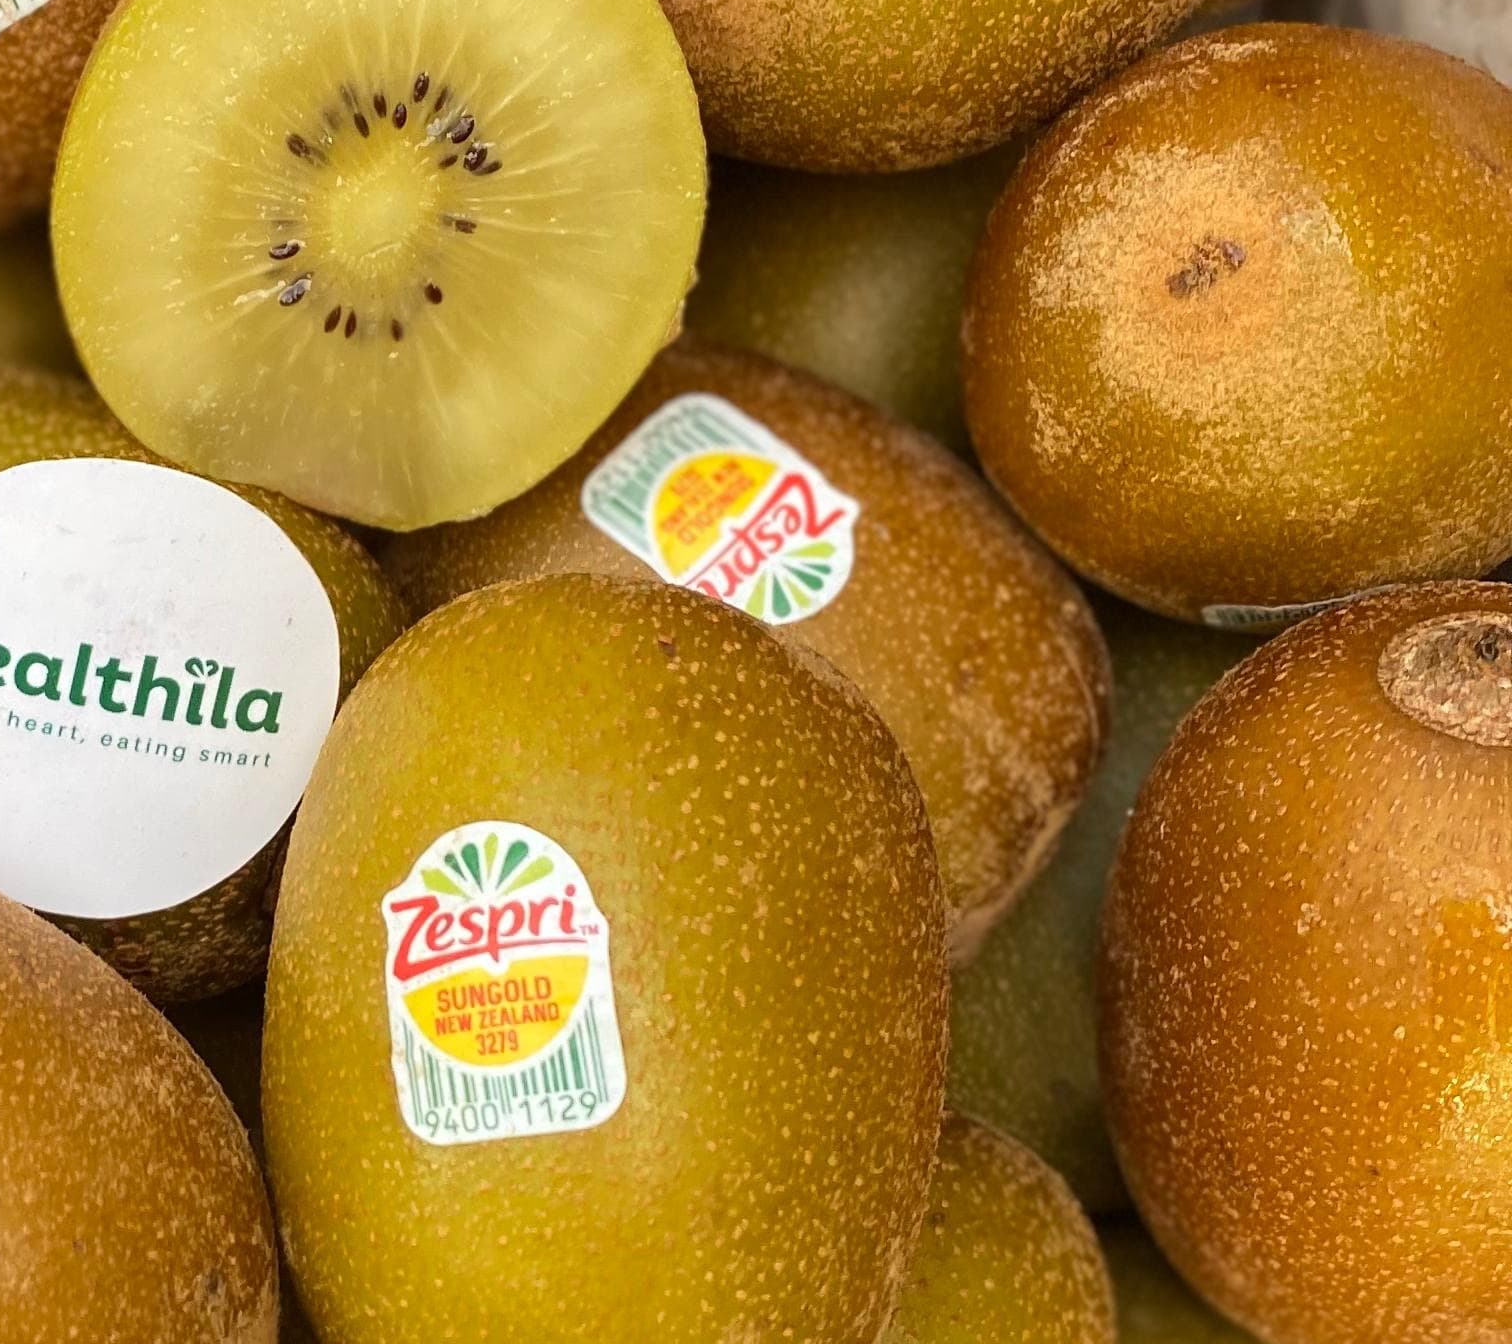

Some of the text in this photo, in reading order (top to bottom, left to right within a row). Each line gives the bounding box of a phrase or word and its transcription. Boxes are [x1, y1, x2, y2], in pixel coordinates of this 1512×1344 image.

[7, 711, 86, 745] heart,
[100, 732, 187, 763] eating
[199, 748, 272, 768] smart
[390, 884, 588, 982] Zespri
[437, 976, 551, 1013] SUNGOLD
[434, 1002, 559, 1036] NEW ZEALAND
[475, 1030, 519, 1056] 3279
[424, 1091, 597, 1138] 9400 1129
